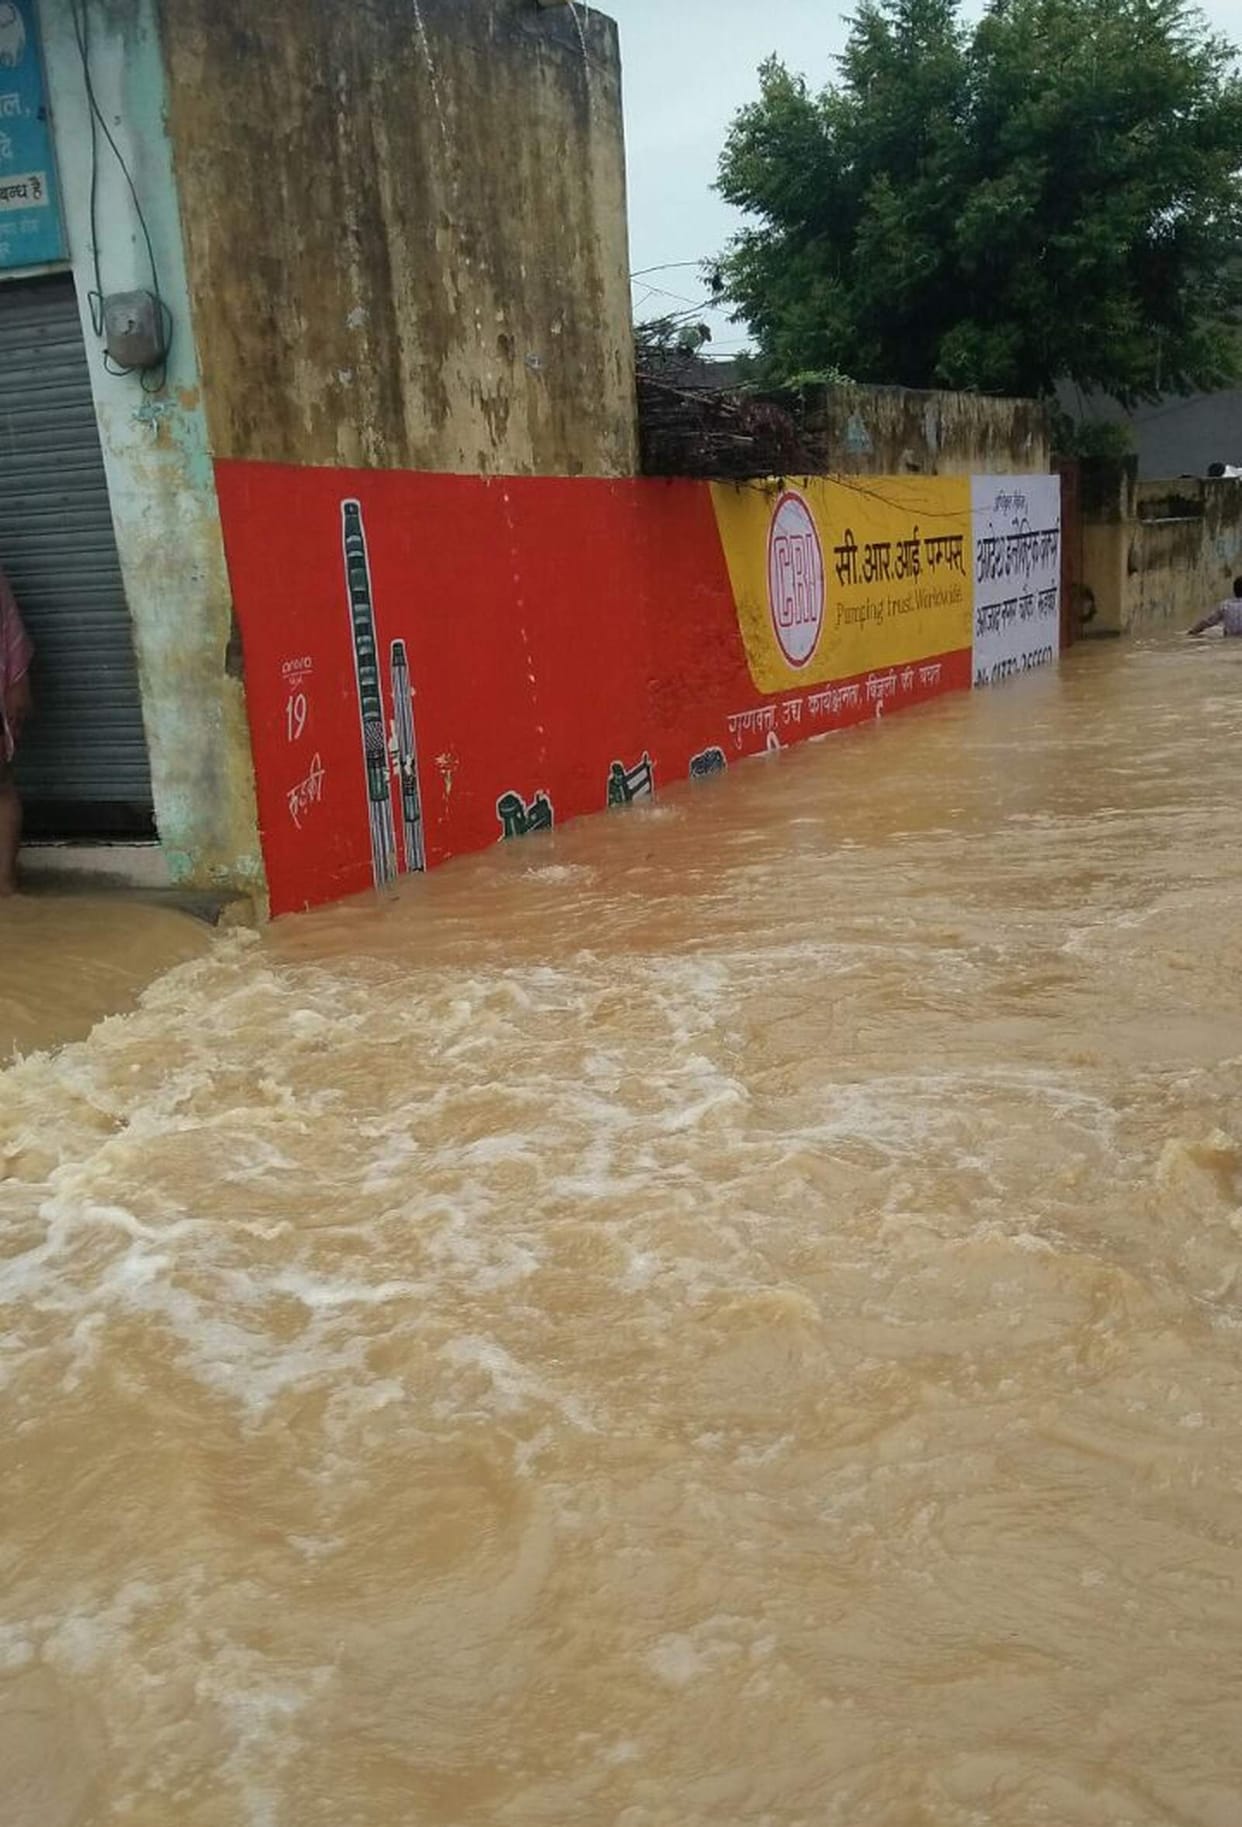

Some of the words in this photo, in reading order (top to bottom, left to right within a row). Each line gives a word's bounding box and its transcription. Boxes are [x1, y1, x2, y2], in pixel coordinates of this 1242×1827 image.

[773, 534, 818, 628] CRI
[834, 598, 884, 631] Pumping
[286, 692, 307, 741] 19
